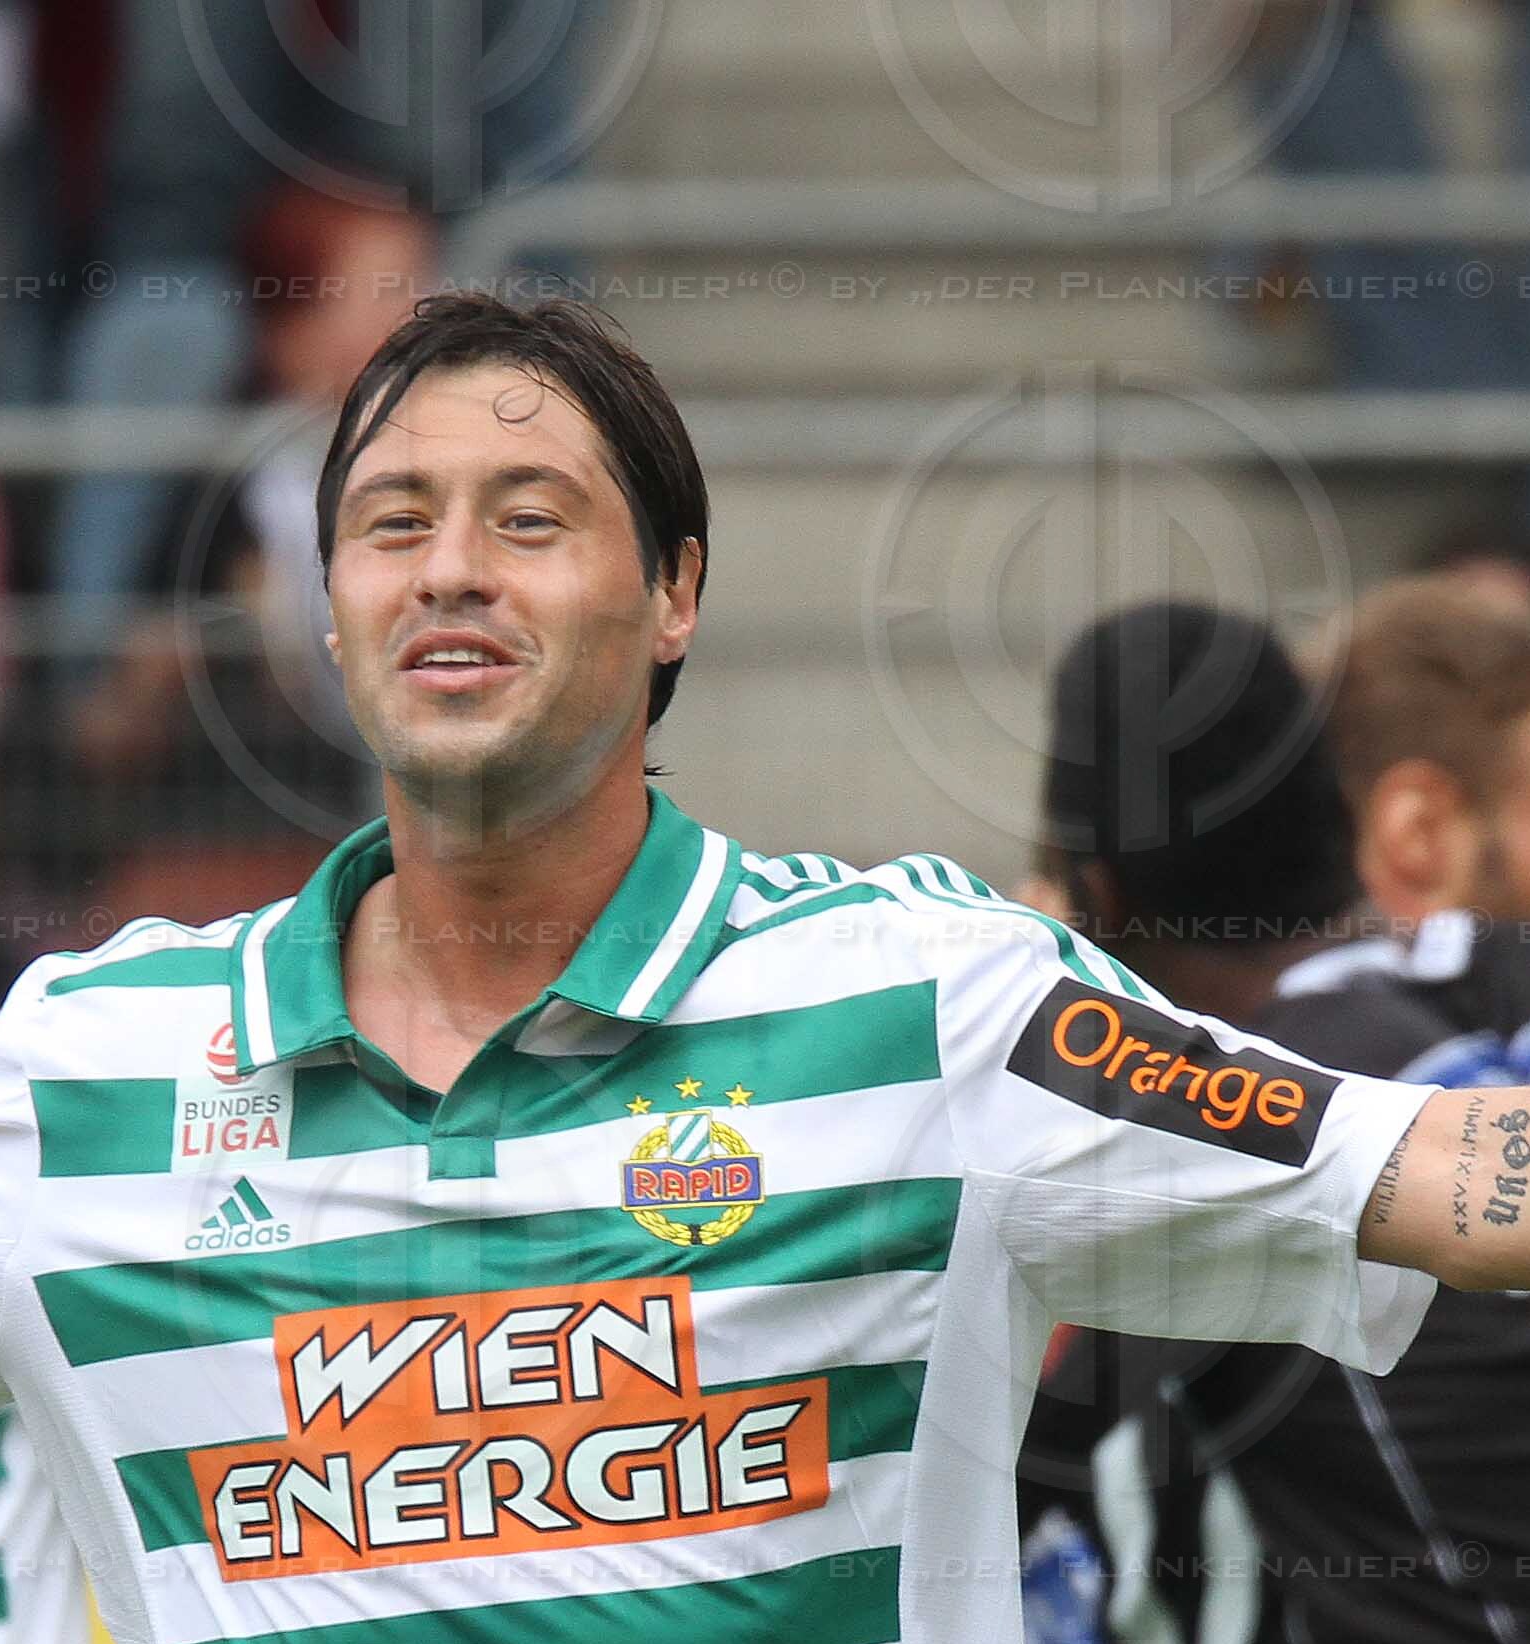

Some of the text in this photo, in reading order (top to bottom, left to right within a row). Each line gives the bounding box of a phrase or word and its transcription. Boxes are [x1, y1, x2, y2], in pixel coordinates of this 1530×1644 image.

[1051, 998, 1305, 1131] Orange
[184, 1094, 281, 1121] BUNDES
[182, 1116, 281, 1157] LIGA
[632, 1163, 753, 1201] RAPID
[184, 1223, 291, 1250] adidas
[288, 1293, 682, 1430] WIEN
[212, 1396, 812, 1567] ENERGIE
